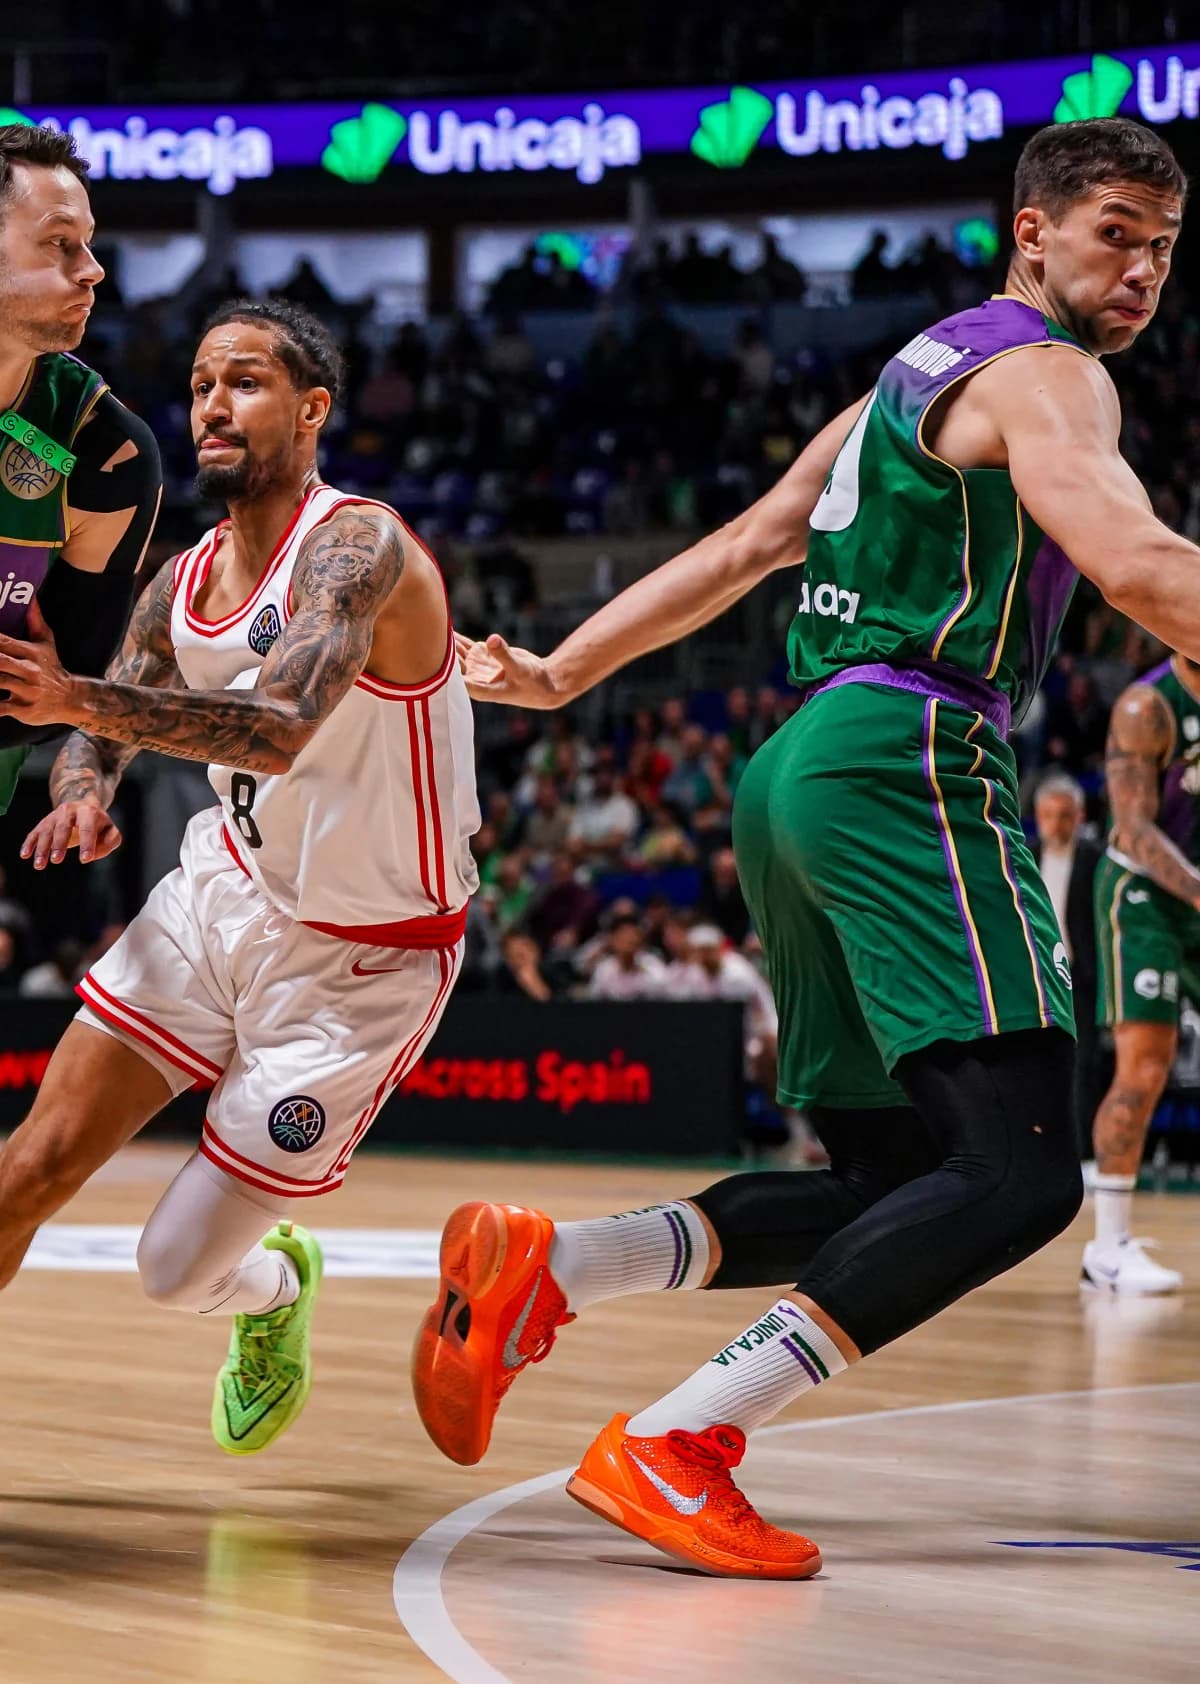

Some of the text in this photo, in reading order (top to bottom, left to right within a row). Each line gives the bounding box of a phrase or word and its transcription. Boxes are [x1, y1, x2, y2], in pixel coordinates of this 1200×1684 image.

[408, 103, 640, 184] Unicaja
[775, 77, 1003, 160] Unicaja
[231, 771, 263, 849] 8
[536, 1049, 651, 1112] Spain
[710, 1312, 788, 1367] UNICAJA
